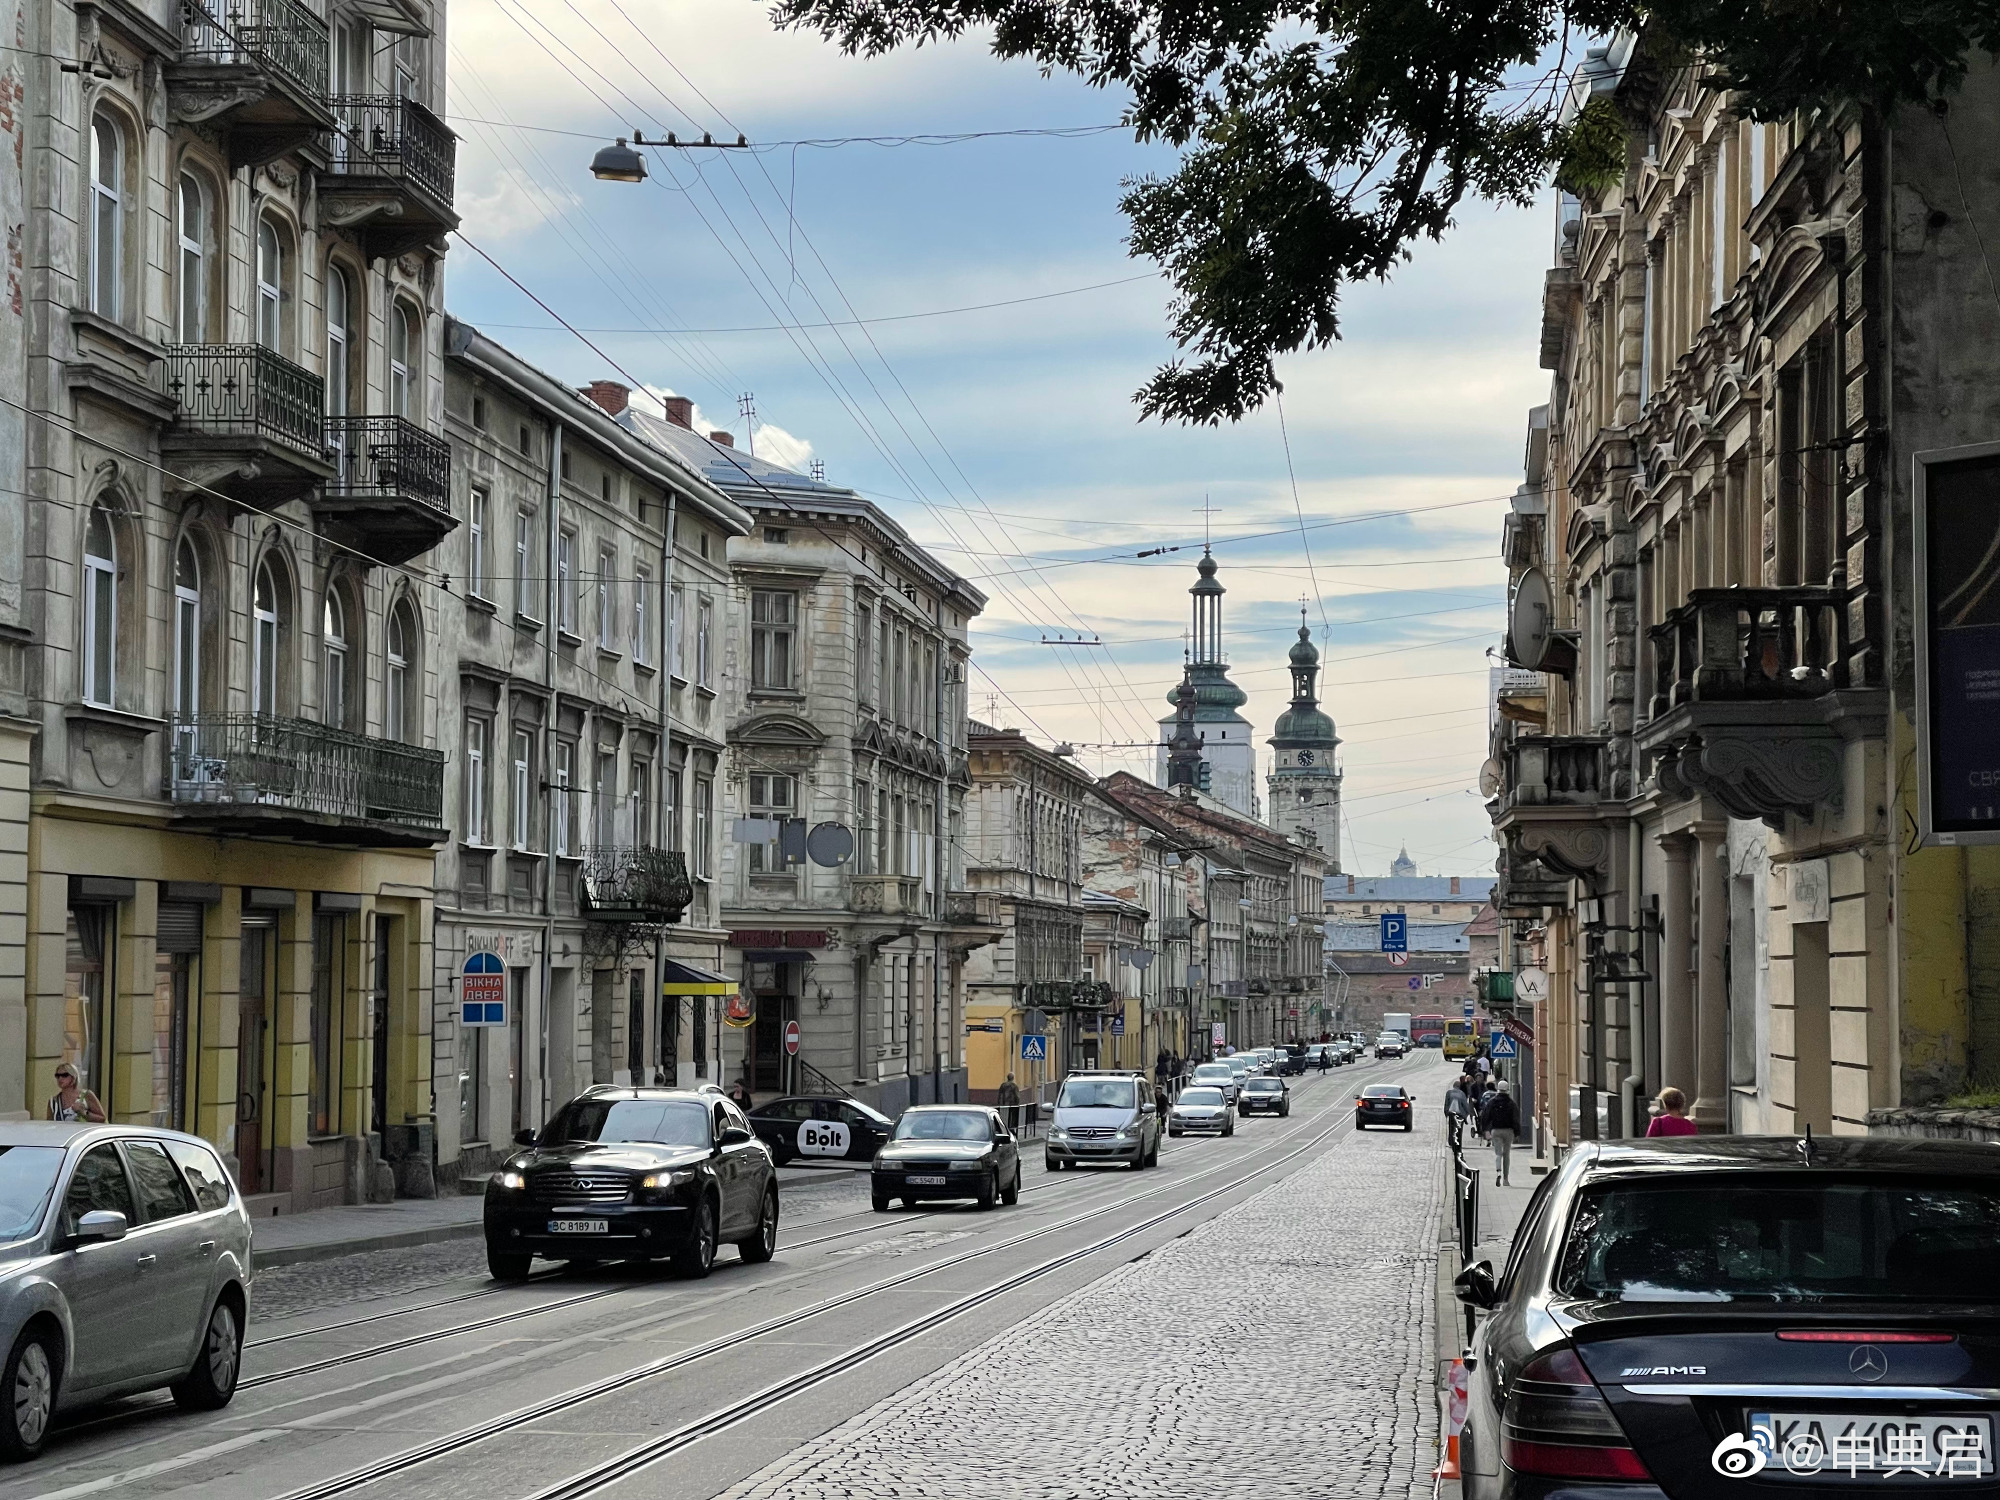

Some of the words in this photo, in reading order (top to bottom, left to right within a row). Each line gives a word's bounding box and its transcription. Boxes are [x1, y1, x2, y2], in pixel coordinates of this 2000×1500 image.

[1387, 921, 1400, 939] P
[465, 977, 502, 988] ВІКНА
[465, 990, 502, 1000] ДВЕРІ
[806, 1129, 841, 1147] Bolt
[552, 1221, 566, 1231] BC
[568, 1221, 590, 1231] 8189
[593, 1221, 605, 1231] IA
[1651, 1366, 1706, 1375] AMG
[1775, 1419, 1829, 1455] KA
